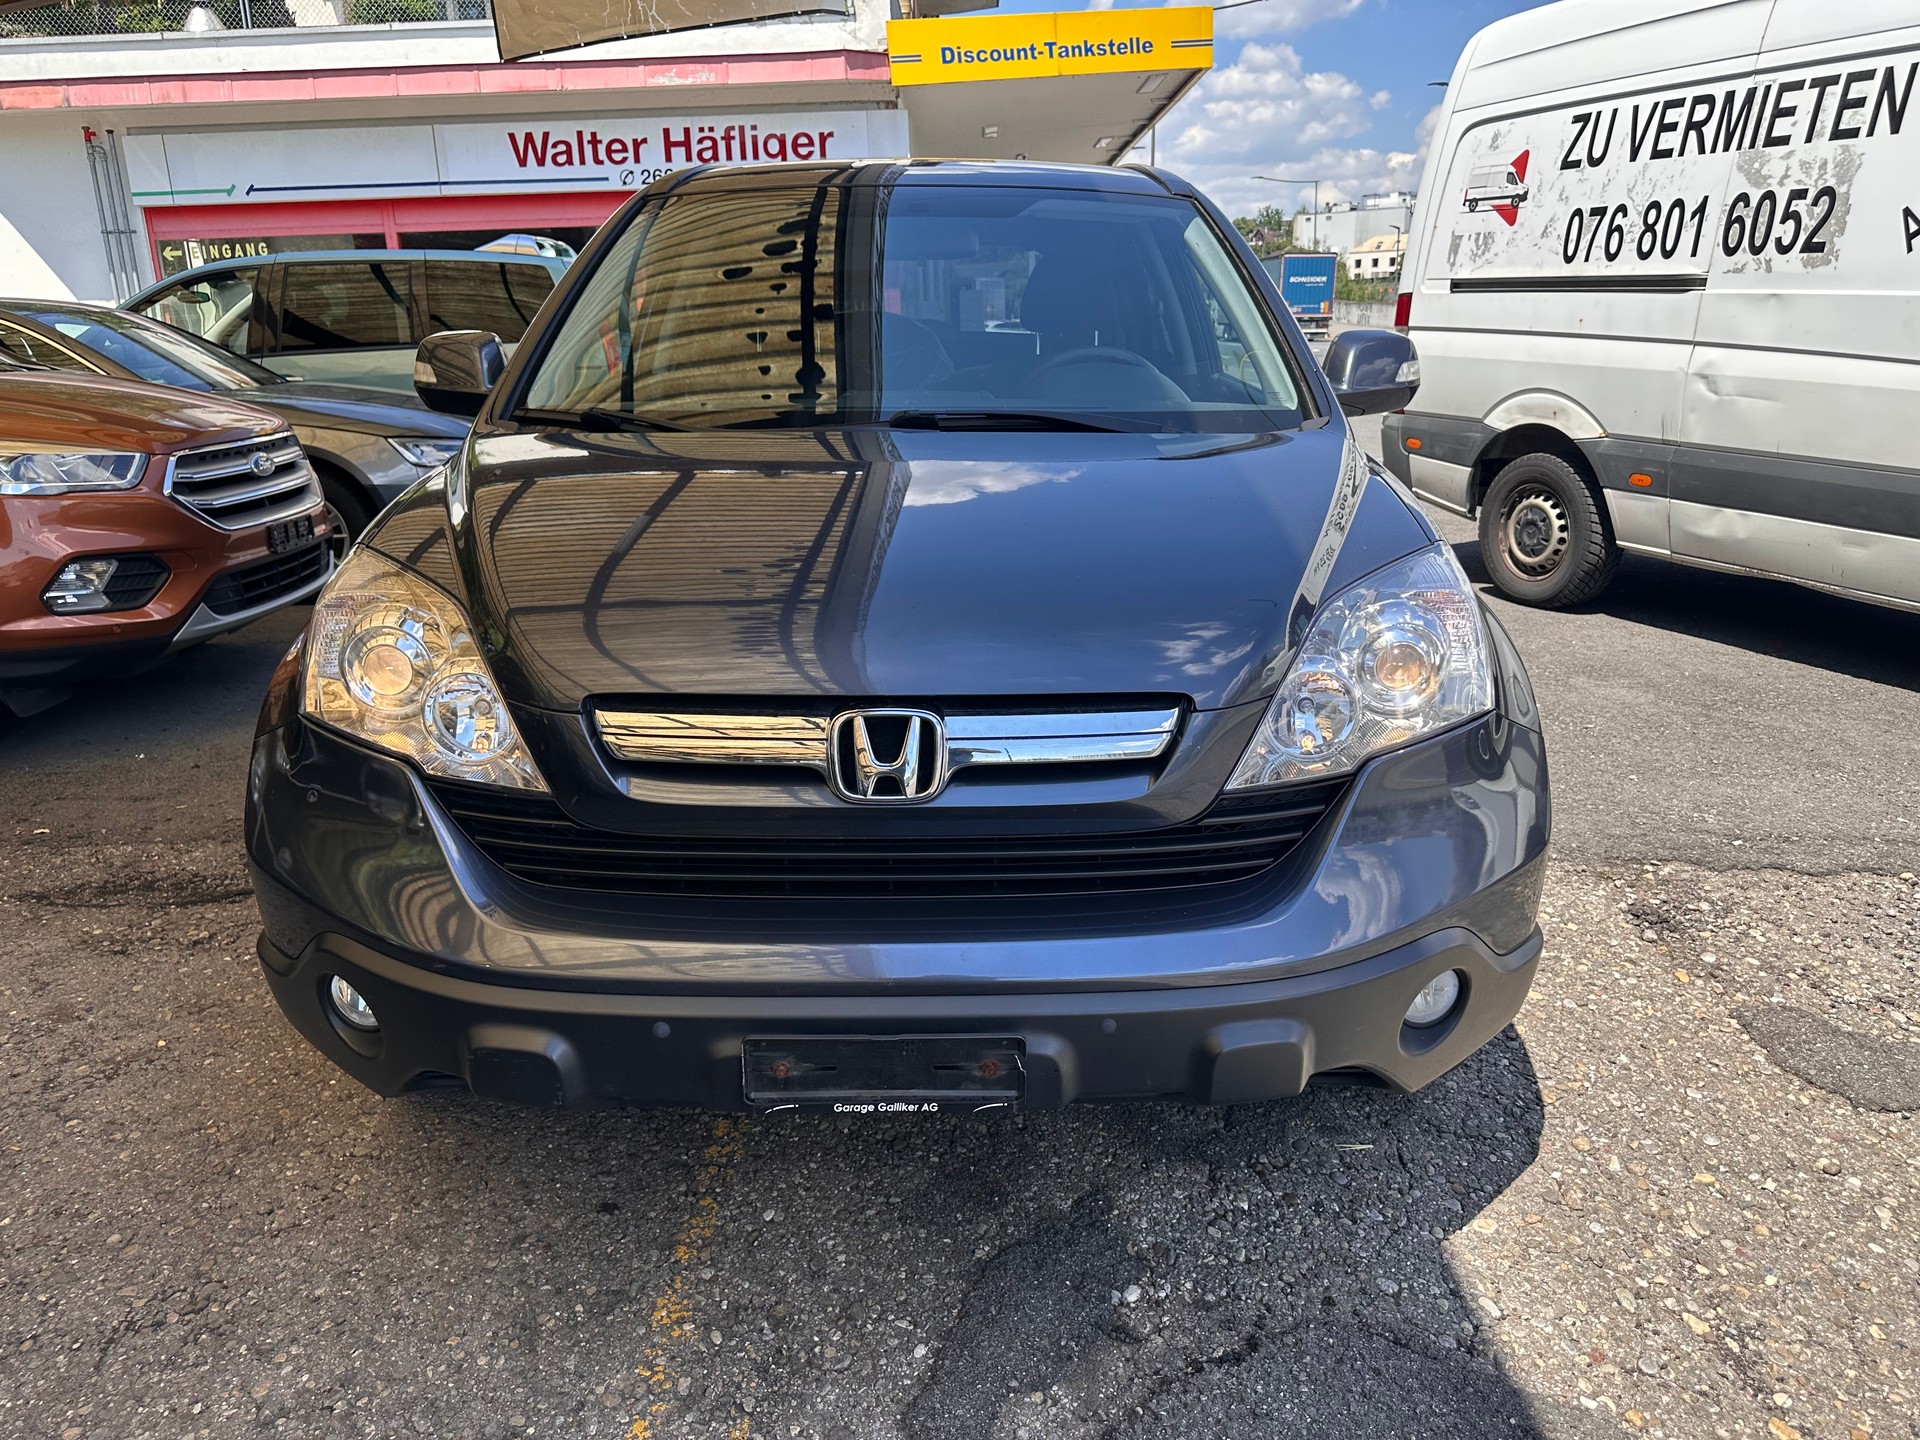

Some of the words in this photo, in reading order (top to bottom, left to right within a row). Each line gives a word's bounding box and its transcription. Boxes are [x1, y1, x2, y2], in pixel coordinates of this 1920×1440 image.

[941, 37, 1153, 64] Discount-Tankstelle
[1559, 108, 1619, 171] ZU
[1629, 62, 1920, 163] VERMIETEN
[507, 130, 648, 167] Walter
[662, 125, 834, 163] Häfliger
[1562, 203, 1628, 265] 076
[1636, 195, 1709, 261] 801
[1721, 186, 1837, 257] 6052
[191, 242, 268, 259] EINGANG
[833, 1103, 875, 1114] Garage
[877, 1103, 919, 1112] Galliker
[921, 1103, 939, 1112] AG
